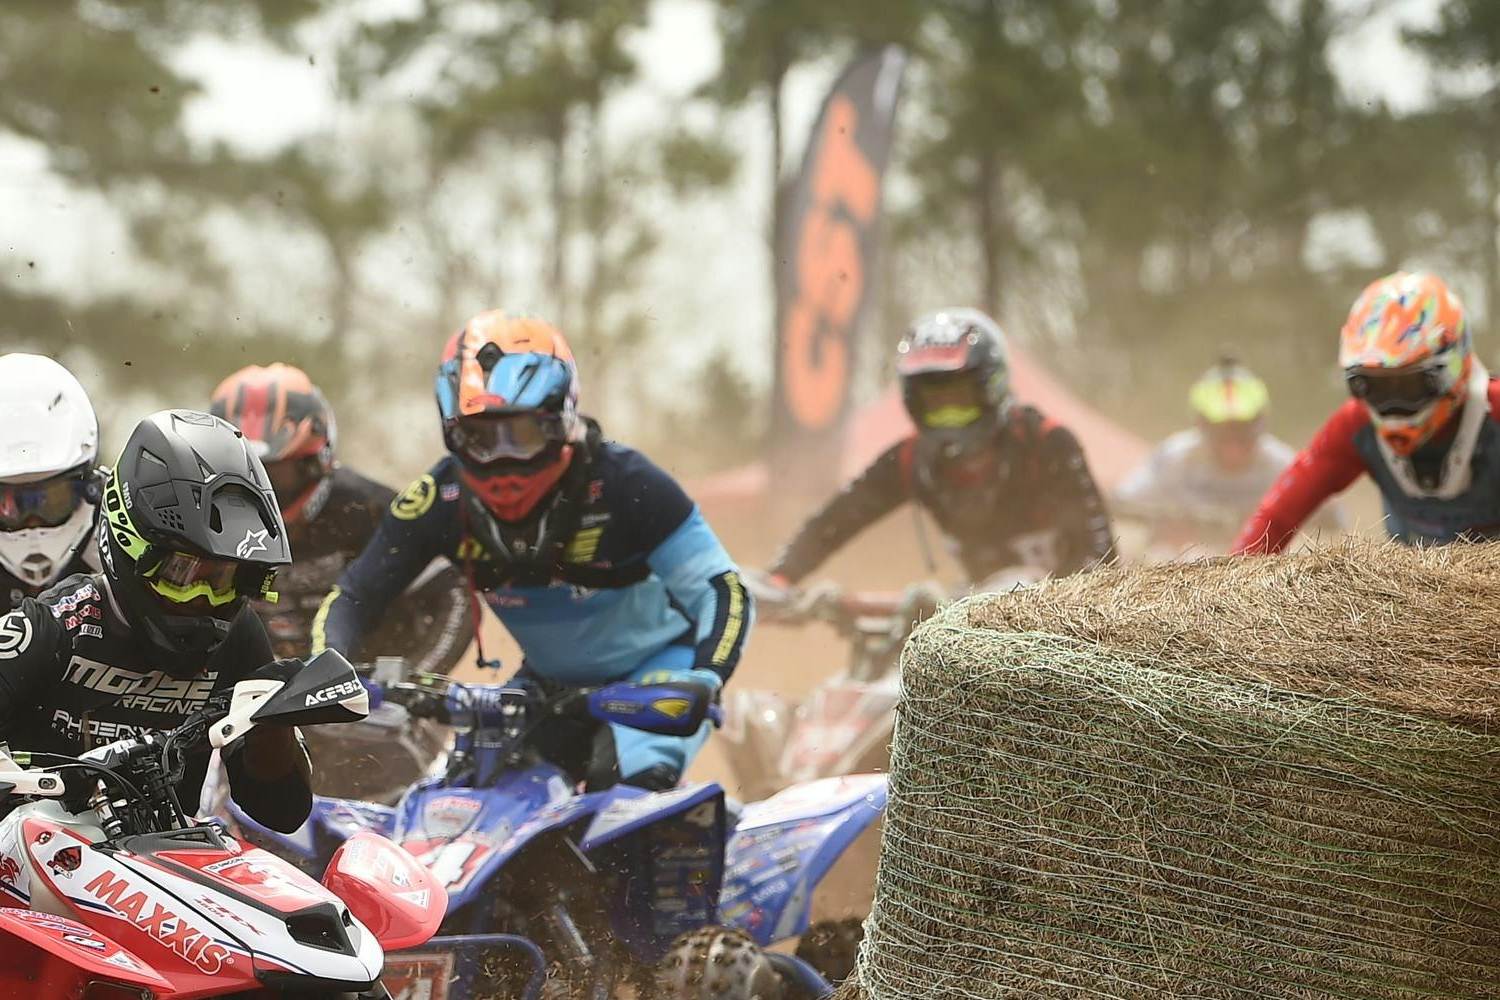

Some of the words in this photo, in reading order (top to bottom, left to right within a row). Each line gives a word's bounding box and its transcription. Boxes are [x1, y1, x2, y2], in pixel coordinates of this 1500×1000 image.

[60, 654, 219, 701] MOOSE
[113, 694, 206, 716] RACING
[83, 869, 230, 975] MAXXIS
